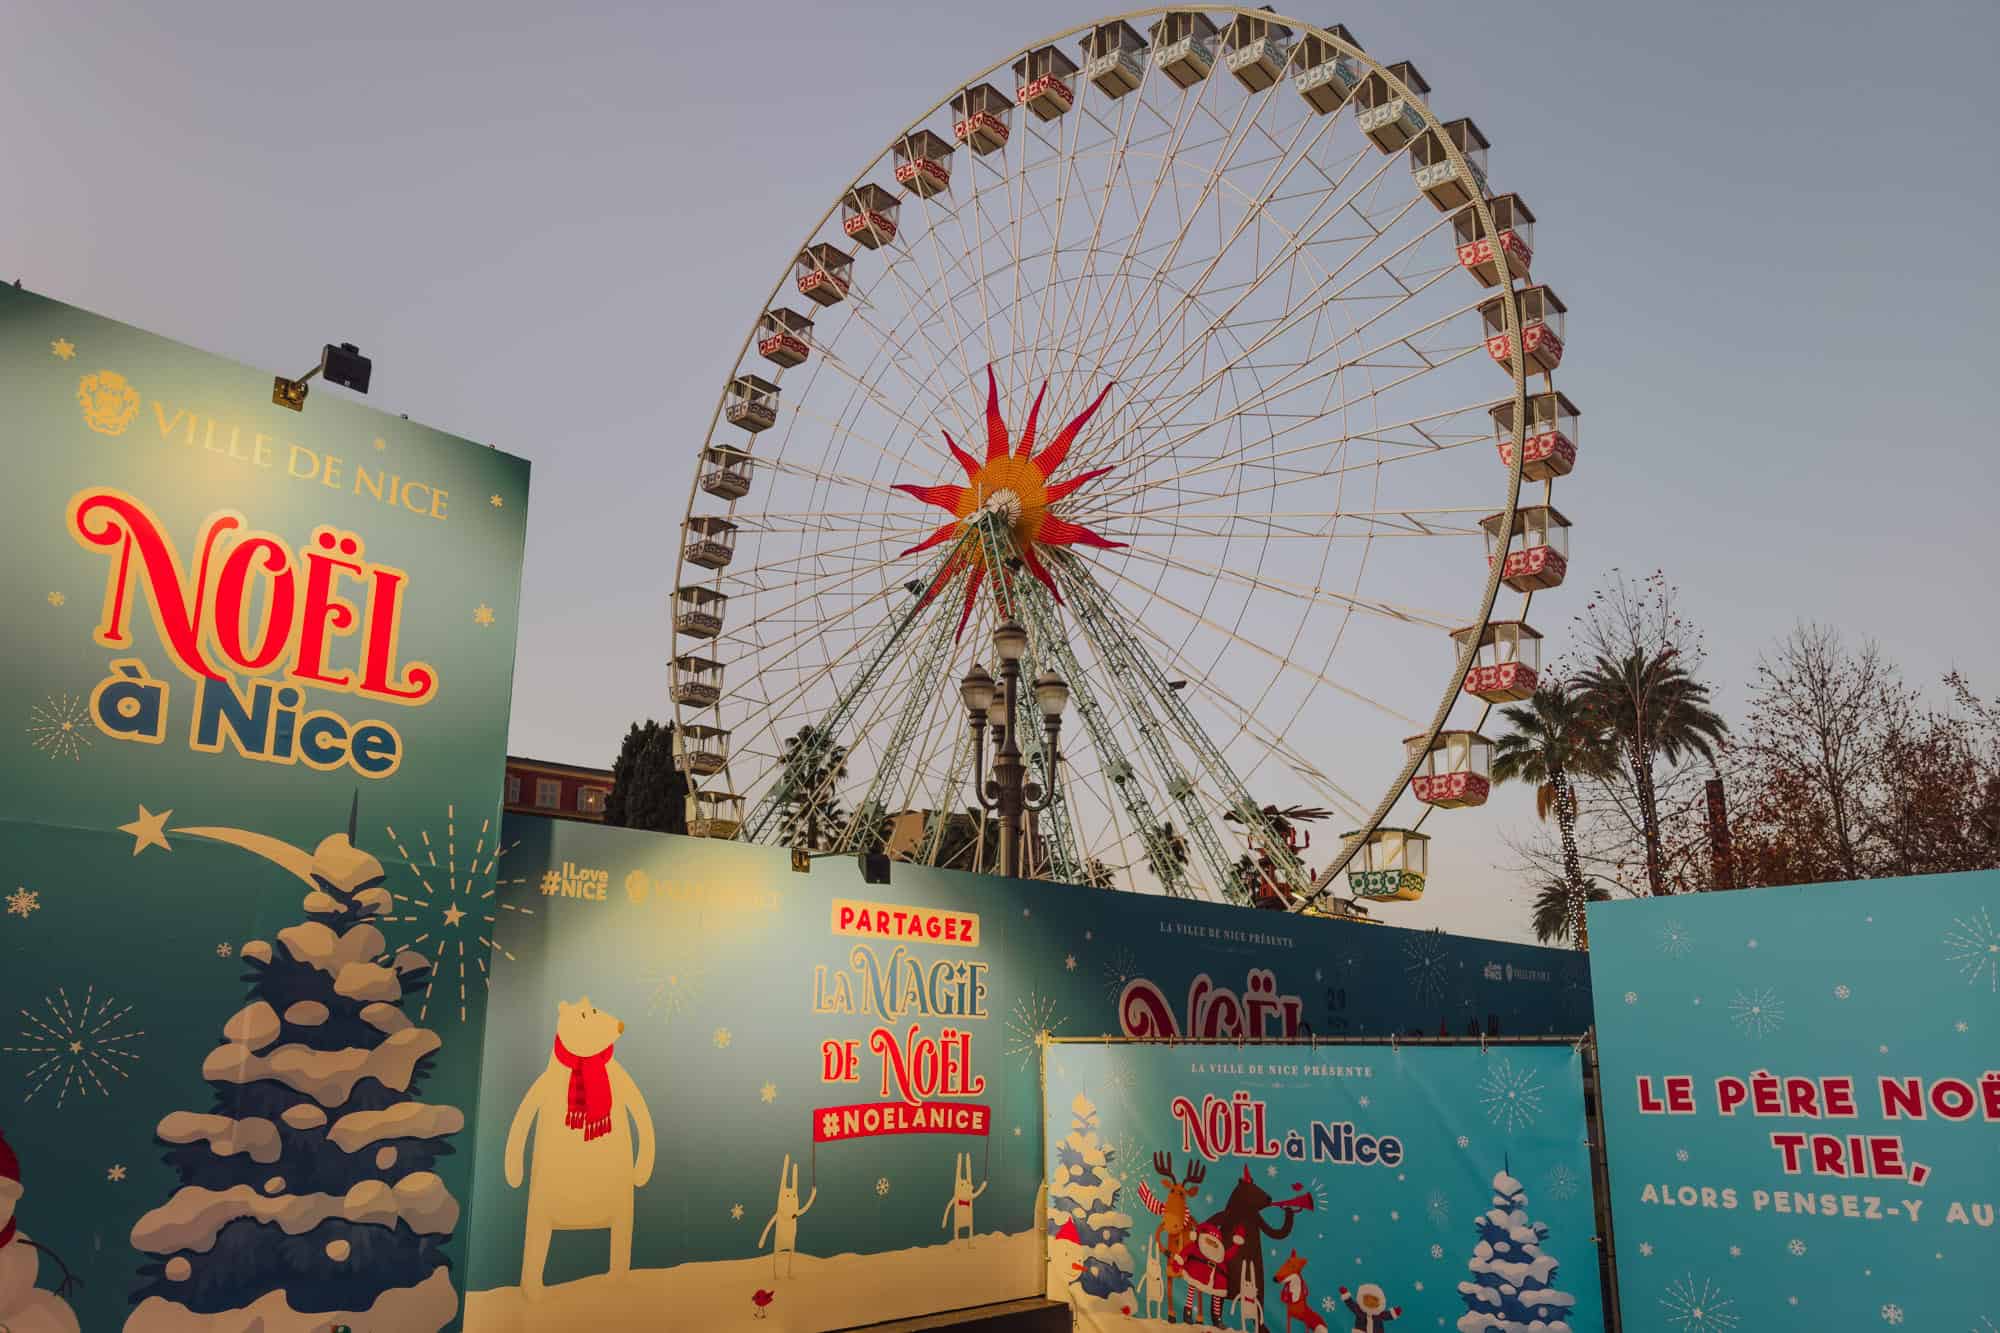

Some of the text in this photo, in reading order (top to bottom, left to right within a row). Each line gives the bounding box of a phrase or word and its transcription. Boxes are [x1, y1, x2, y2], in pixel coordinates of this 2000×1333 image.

[152, 400, 449, 520] VILLE DE NICE
[68, 488, 436, 704] NOËL
[91, 658, 402, 778] à Nice
[561, 879, 608, 900] NICE
[840, 907, 973, 942] PARTAGEZ
[813, 965, 855, 1014] LA
[821, 1023, 985, 1106] DE NOËL
[1191, 1063, 1204, 1073] LA
[1209, 1063, 1244, 1074] VILLE
[1249, 1064, 1264, 1075] DE
[1269, 1065, 1299, 1076] NICE
[1636, 1074, 1696, 1115] LE
[1715, 1068, 1858, 1120] PÈRE
[1172, 1091, 1403, 1167] NOËL à Nice
[1770, 1132, 1931, 1187] TRIE,
[1640, 1183, 2000, 1226] ALORS PENSEZ-Y AU
